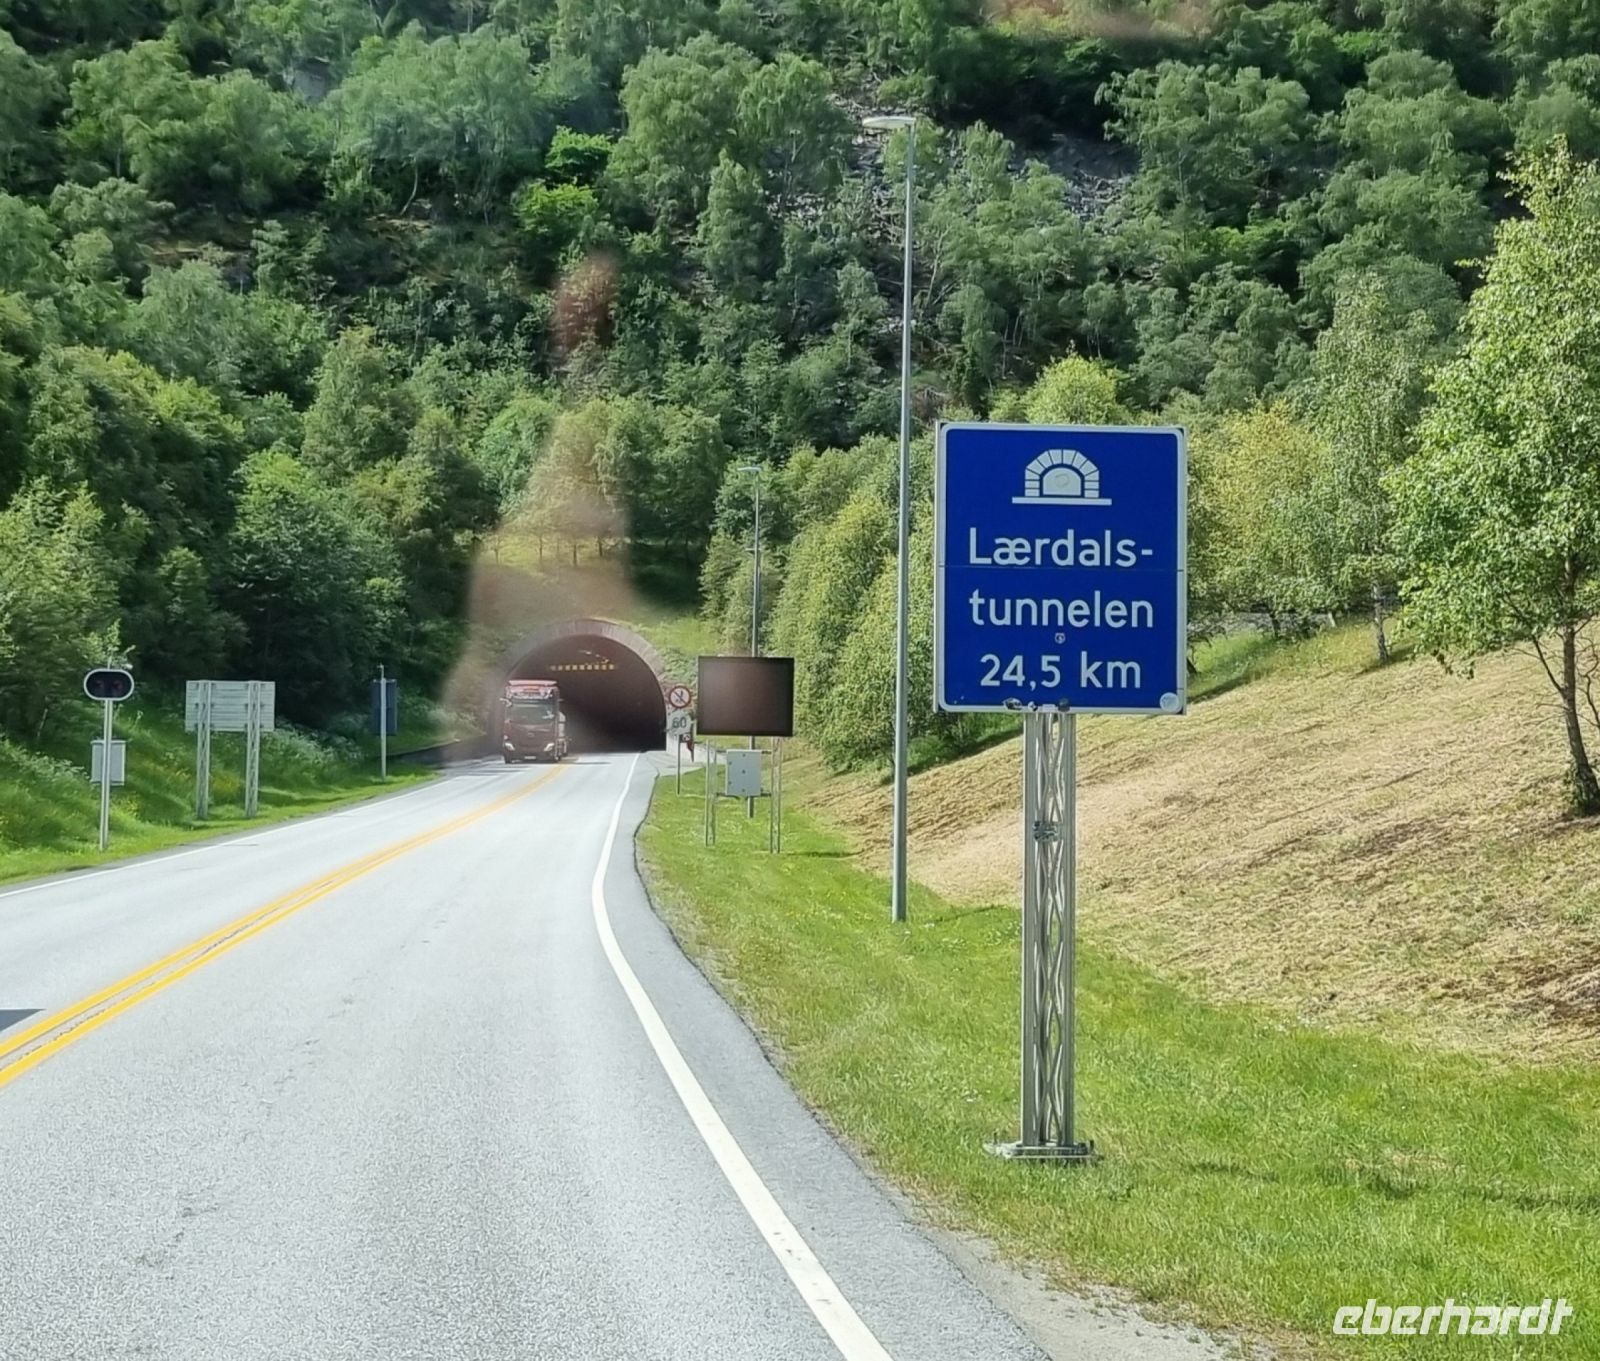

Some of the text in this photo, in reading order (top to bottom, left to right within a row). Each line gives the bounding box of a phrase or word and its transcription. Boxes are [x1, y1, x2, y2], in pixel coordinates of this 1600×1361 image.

[969, 527, 1153, 567] Lærdals-
[968, 588, 1153, 628] tunnelen
[980, 651, 1141, 691] 24,5 km
[672, 716, 687, 729] 60
